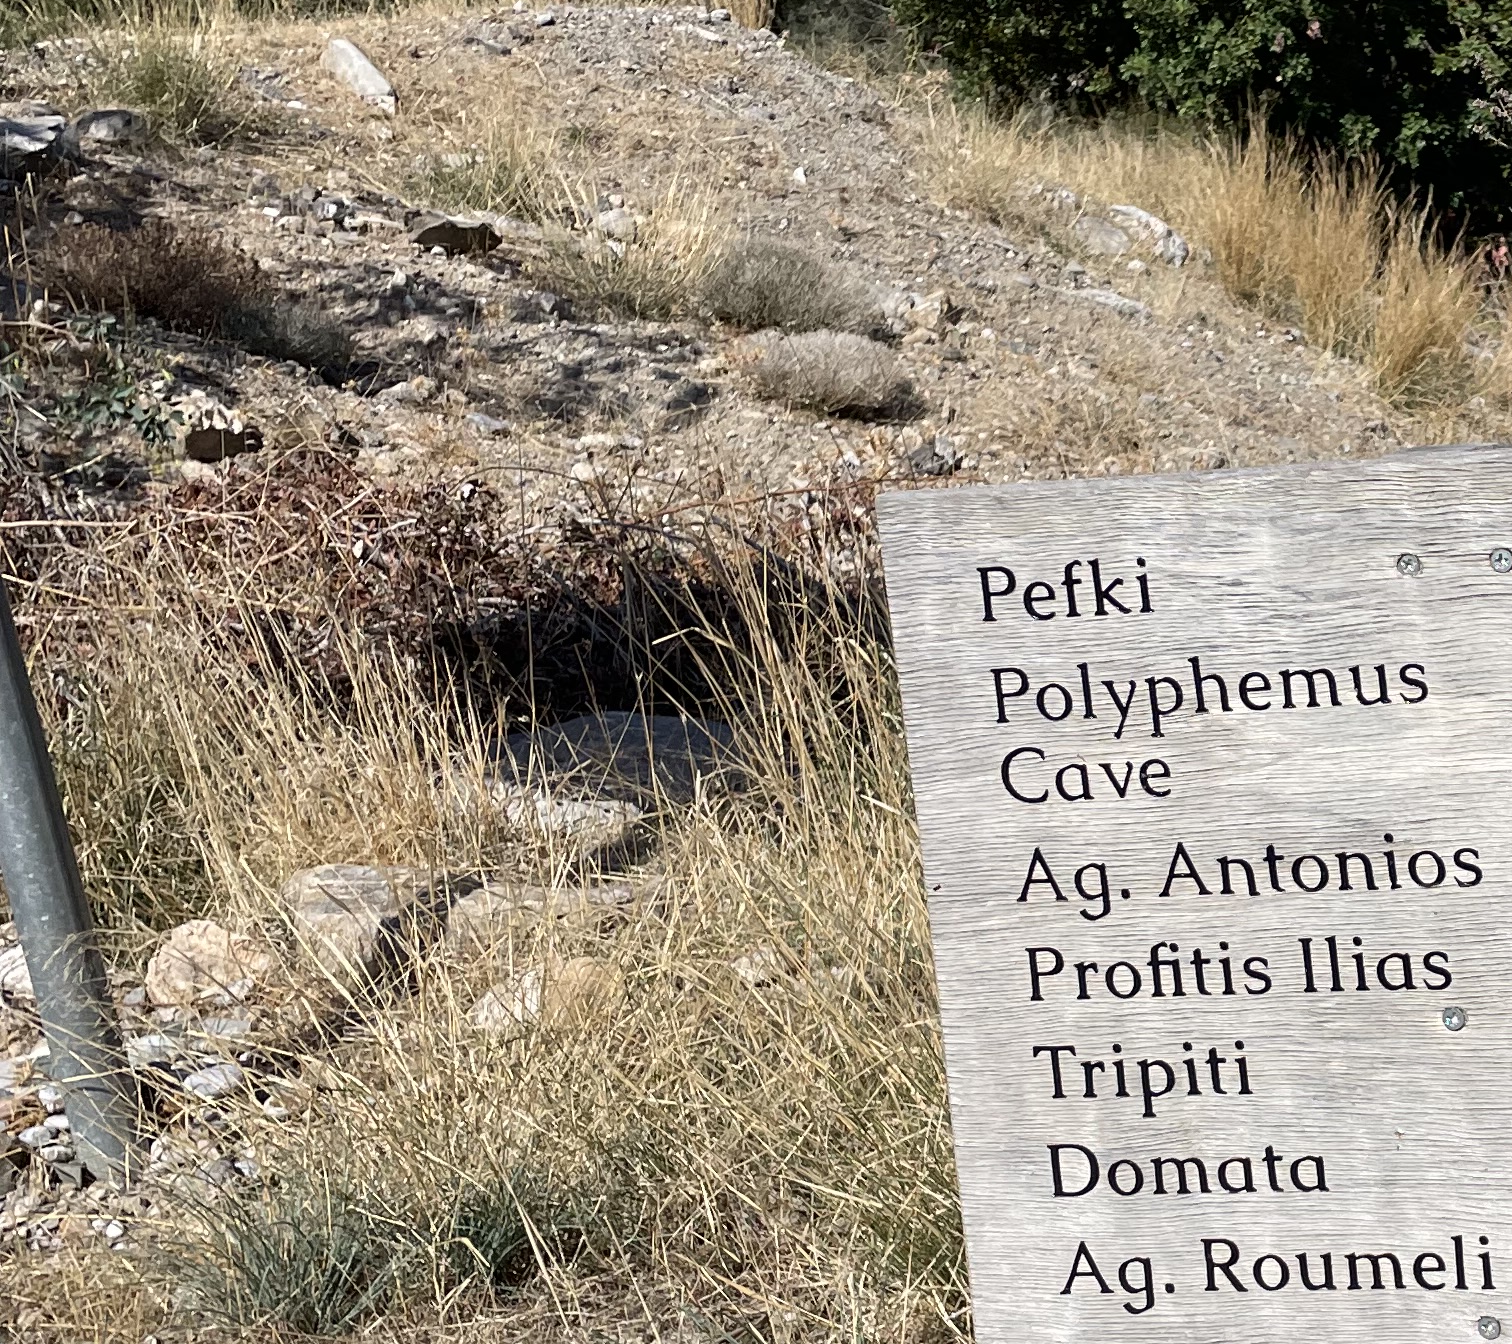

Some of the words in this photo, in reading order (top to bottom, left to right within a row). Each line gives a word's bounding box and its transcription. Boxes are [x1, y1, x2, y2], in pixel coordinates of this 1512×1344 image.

[976, 558, 1155, 622] Pefki
[989, 655, 1429, 740] Polyphemus
[1000, 746, 1172, 804] Cave
[1016, 847, 1131, 921] Ag.
[1158, 833, 1483, 898] Antonios
[1024, 941, 1272, 1002] Profitis
[1297, 935, 1453, 993] Ilias
[1032, 1040, 1254, 1118] Tripiti
[1046, 1143, 1330, 1198] Domata
[1059, 1240, 1175, 1315] Ag.
[1200, 1235, 1497, 1293] Roumeli
